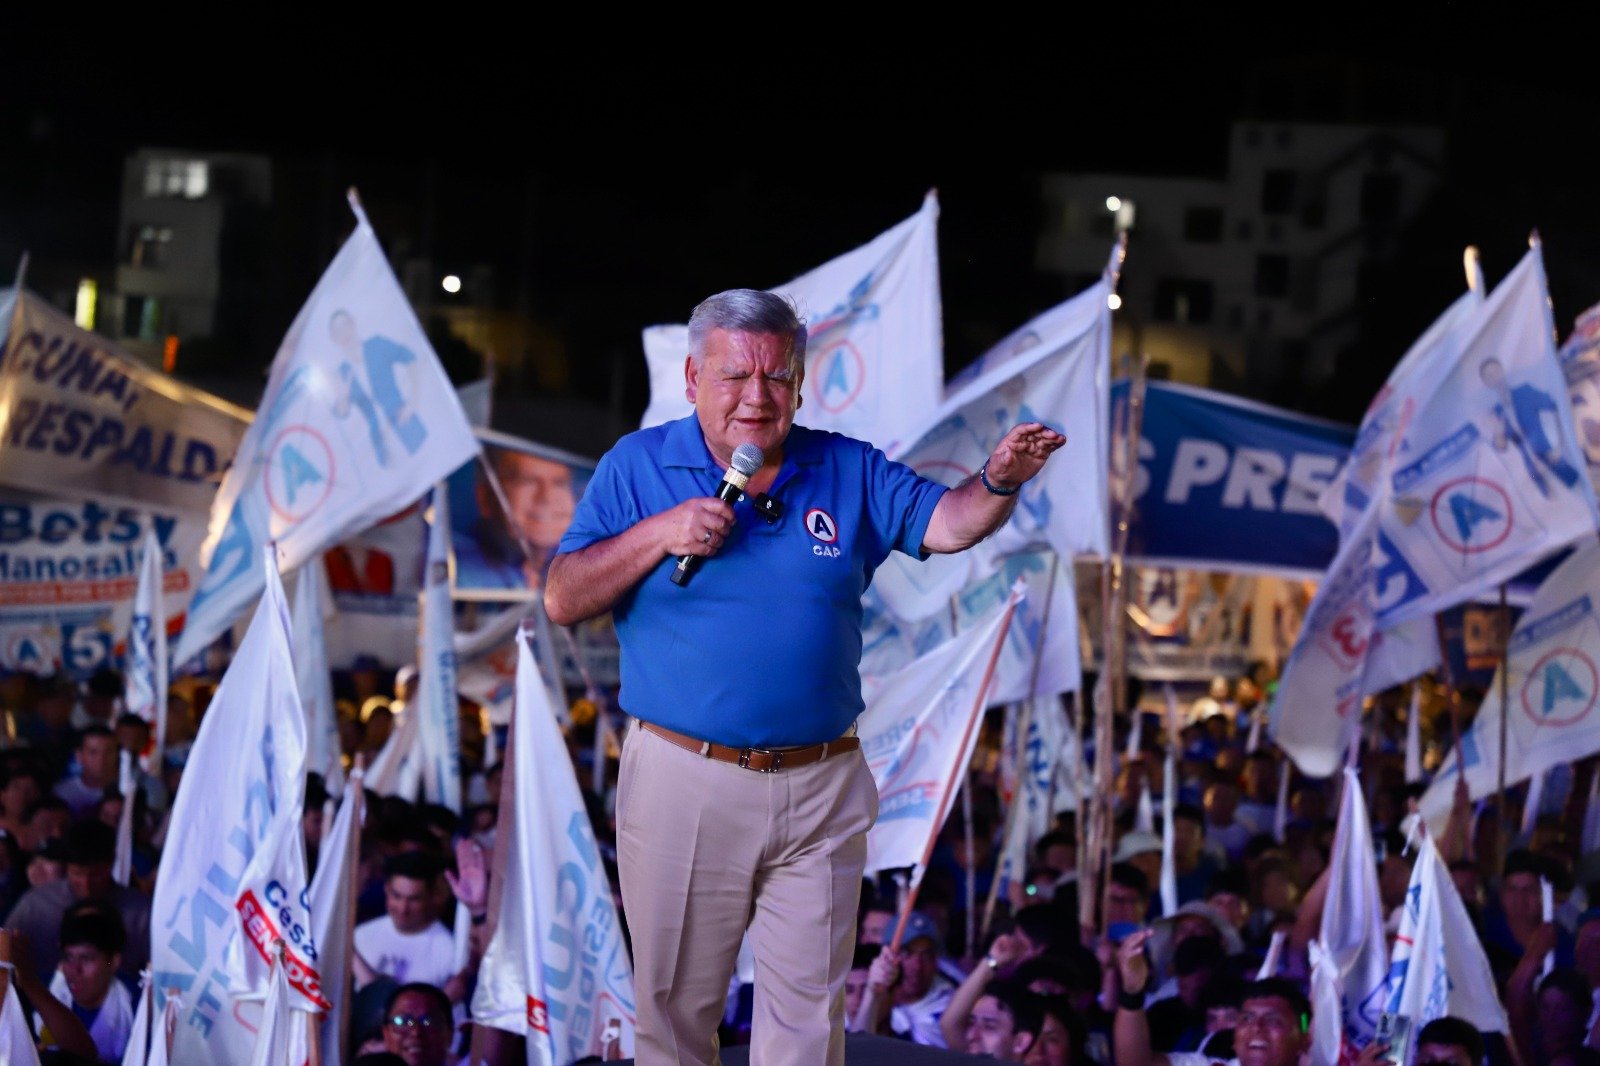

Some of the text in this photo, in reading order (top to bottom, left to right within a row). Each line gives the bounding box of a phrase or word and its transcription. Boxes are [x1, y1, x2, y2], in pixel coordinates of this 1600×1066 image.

[10, 399, 237, 490] RESPALD
[281, 443, 323, 506] A
[1165, 437, 1342, 515] PRE
[814, 513, 833, 537] A
[1448, 493, 1503, 543] A
[812, 544, 841, 558] CAP
[1541, 661, 1587, 716] A
[264, 880, 318, 961] Césa
